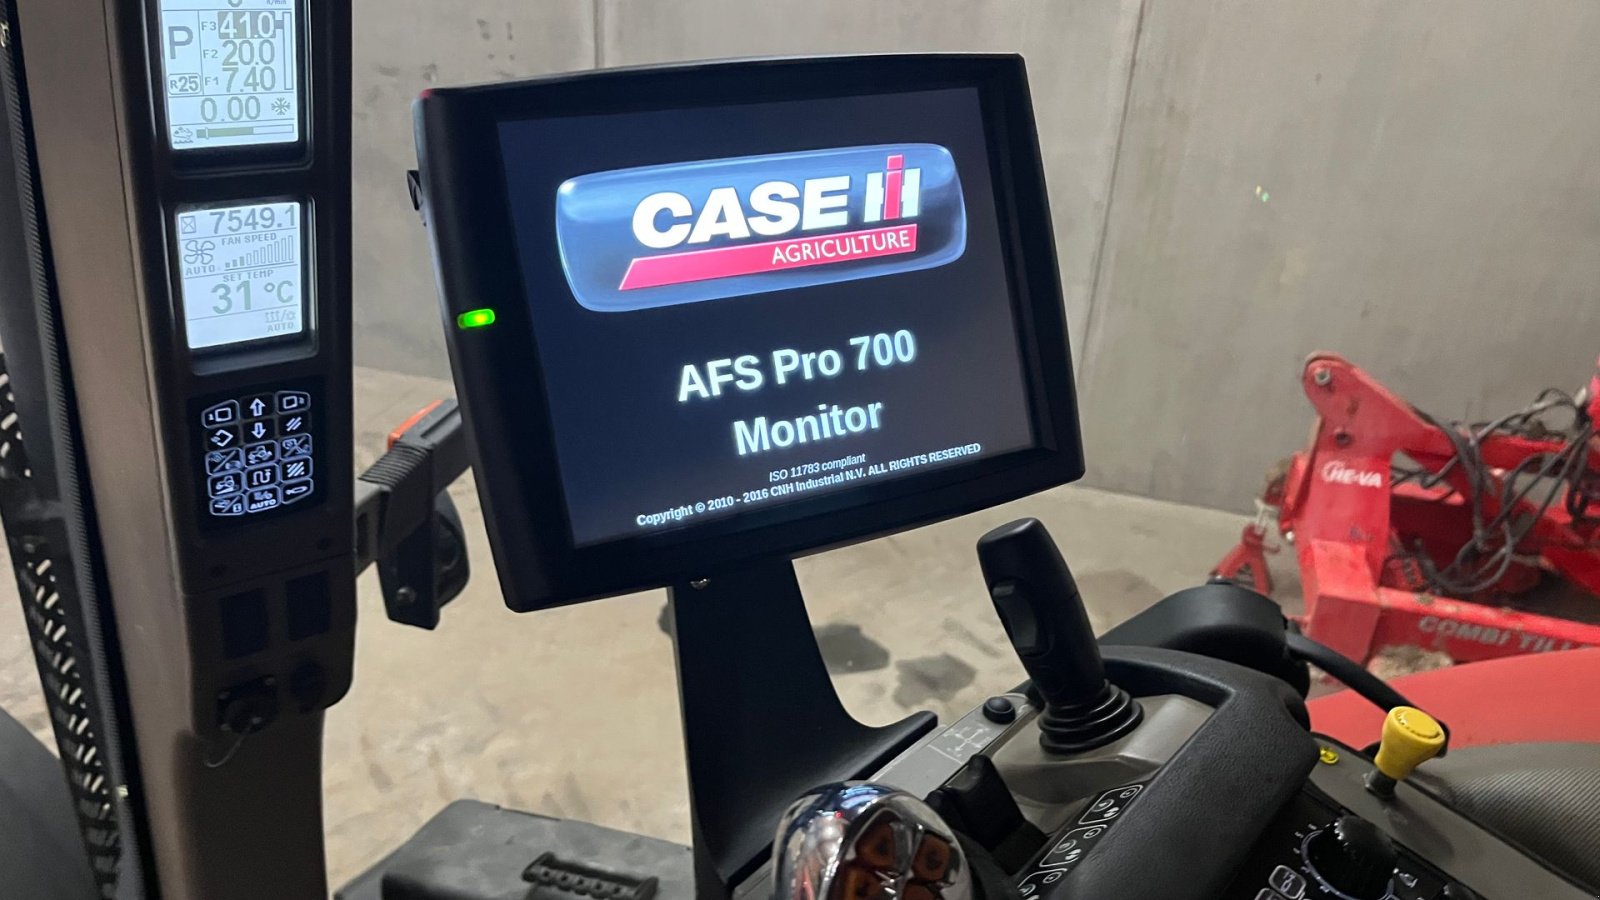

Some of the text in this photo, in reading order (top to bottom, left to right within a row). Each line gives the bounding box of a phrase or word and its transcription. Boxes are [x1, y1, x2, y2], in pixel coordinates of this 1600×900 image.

[201, 11, 275, 38] F3 41.0
[168, 26, 194, 60] P
[203, 39, 275, 66] F2 20.0
[204, 66, 276, 93] F1 7.40
[201, 96, 261, 122] 0.00
[209, 205, 295, 234] 7549.1
[632, 175, 850, 249] CASE
[221, 232, 277, 246] FAN SPEED
[772, 229, 911, 265] AGRICULTURE
[186, 265, 215, 276] AUTO
[223, 270, 274, 283] SET TEMP
[211, 280, 251, 314] 31
[267, 322, 294, 333] AUTO
[678, 329, 917, 402] AFS Pro 700
[733, 401, 883, 456] Monitor
[769, 453, 866, 482] ISO 11783 compliant
[636, 504, 693, 526] Copyright
[707, 496, 734, 511] 2010
[743, 488, 769, 503] 2016
[770, 482, 795, 497] CNH
[796, 472, 844, 492] Industrial
[845, 468, 866, 481] N.V.
[868, 464, 888, 476] ALL
[889, 454, 928, 471] RIGHTS
[929, 442, 981, 463] RESERVED
[250, 499, 277, 510] AUTO
